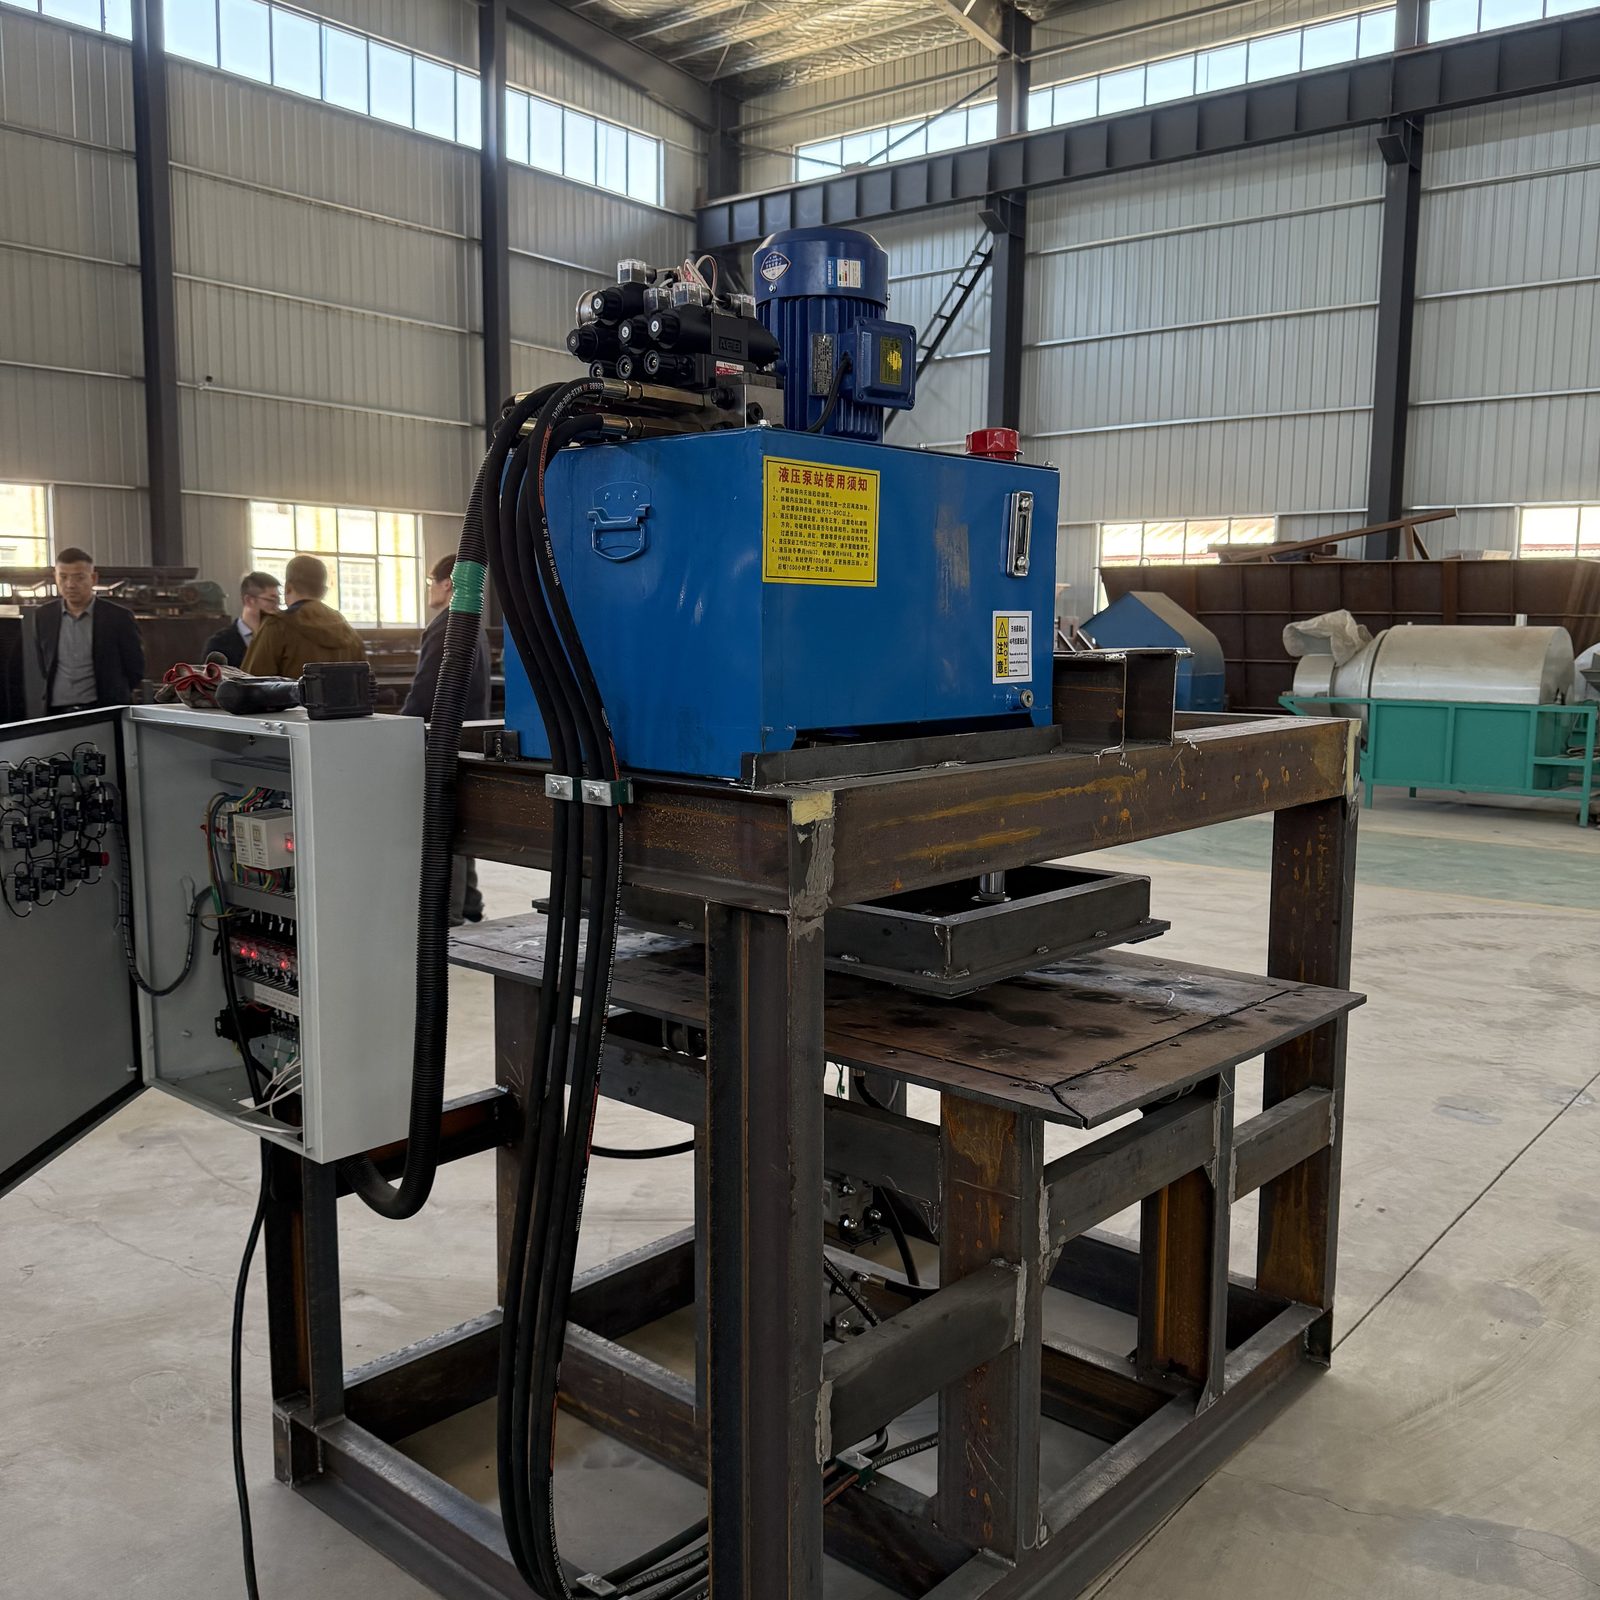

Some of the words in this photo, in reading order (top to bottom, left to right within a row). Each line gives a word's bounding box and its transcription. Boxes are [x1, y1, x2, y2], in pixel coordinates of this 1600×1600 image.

[778, 466, 867, 492] 液压泵站使用须知
[544, 540, 554, 558] MADE
[551, 566, 561, 586] CHINA
[997, 642, 1004, 674] 注意
